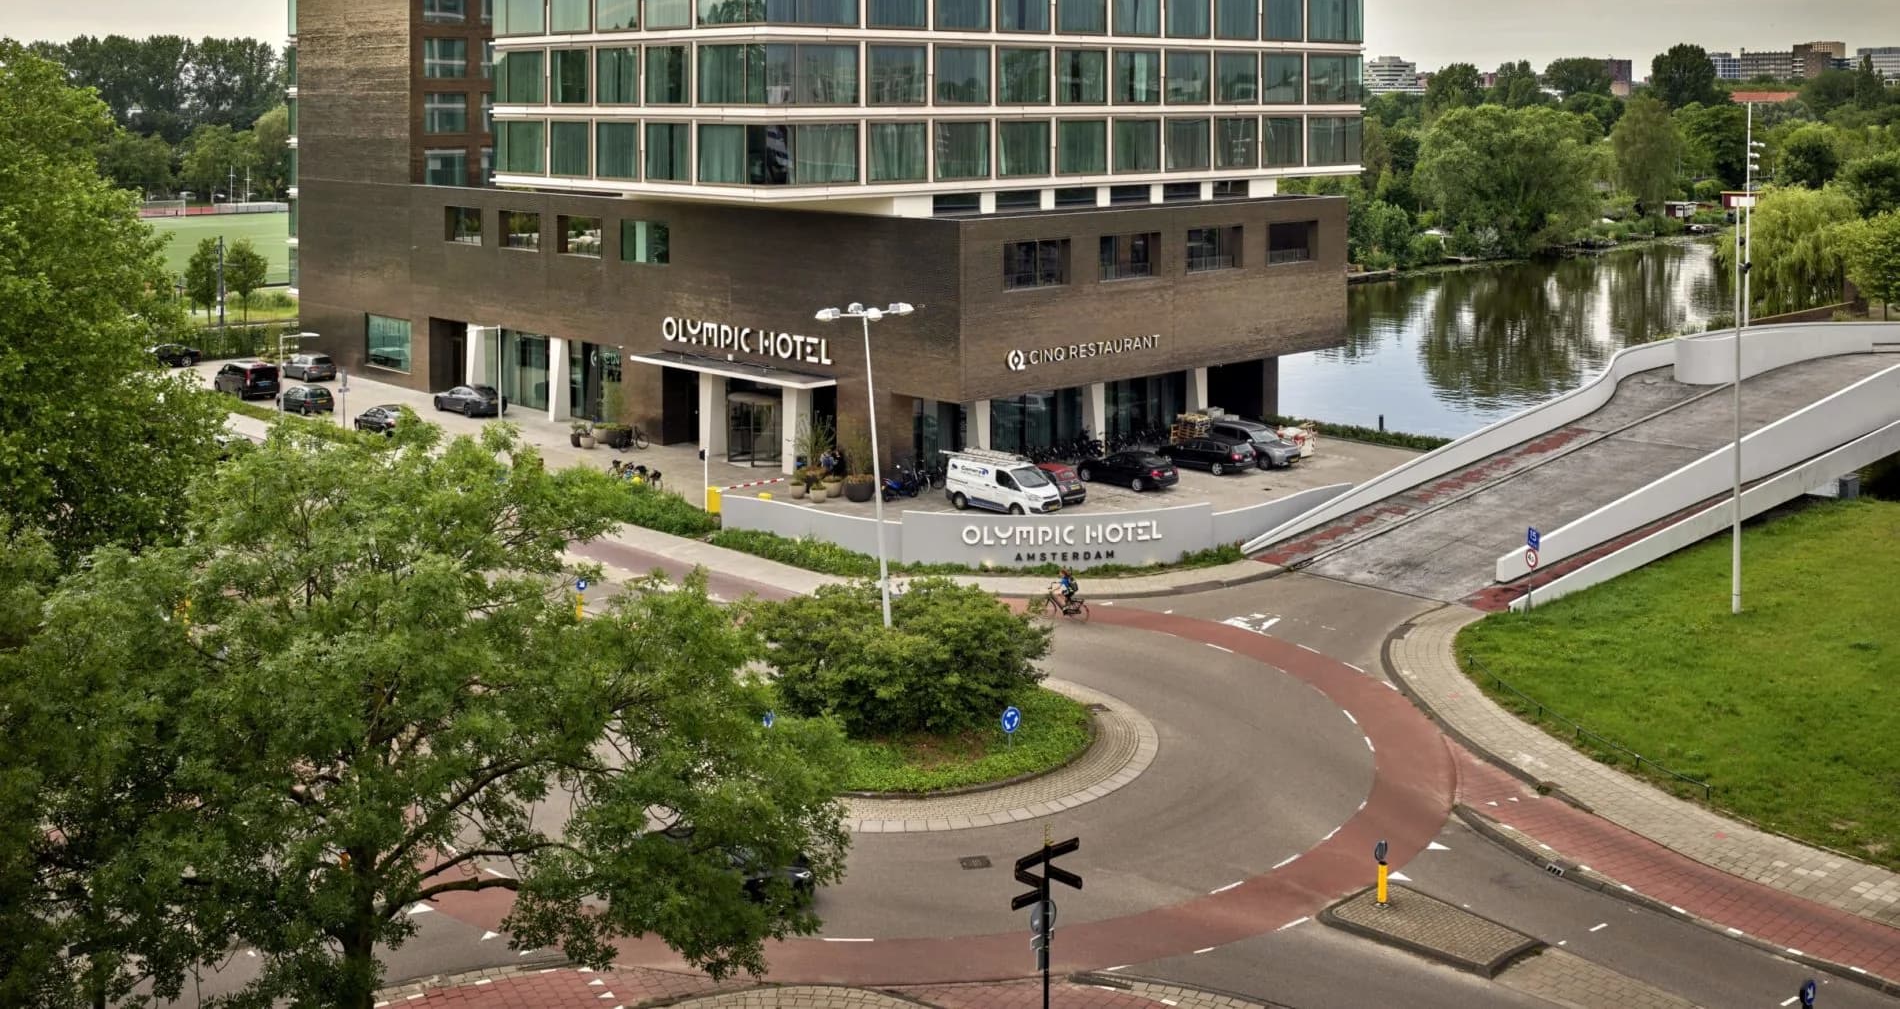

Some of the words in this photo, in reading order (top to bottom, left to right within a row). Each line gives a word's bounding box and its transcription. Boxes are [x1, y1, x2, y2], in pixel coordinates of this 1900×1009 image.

[662, 316, 751, 353] OLYMPIC
[759, 329, 833, 365] HOTEL
[1029, 346, 1065, 365] CINQ
[1069, 334, 1161, 360] RESTAURANT
[962, 525, 1075, 546] OLYMPIC
[1085, 520, 1163, 545] HOTEL
[1015, 550, 1115, 562] AMSTERDAM
